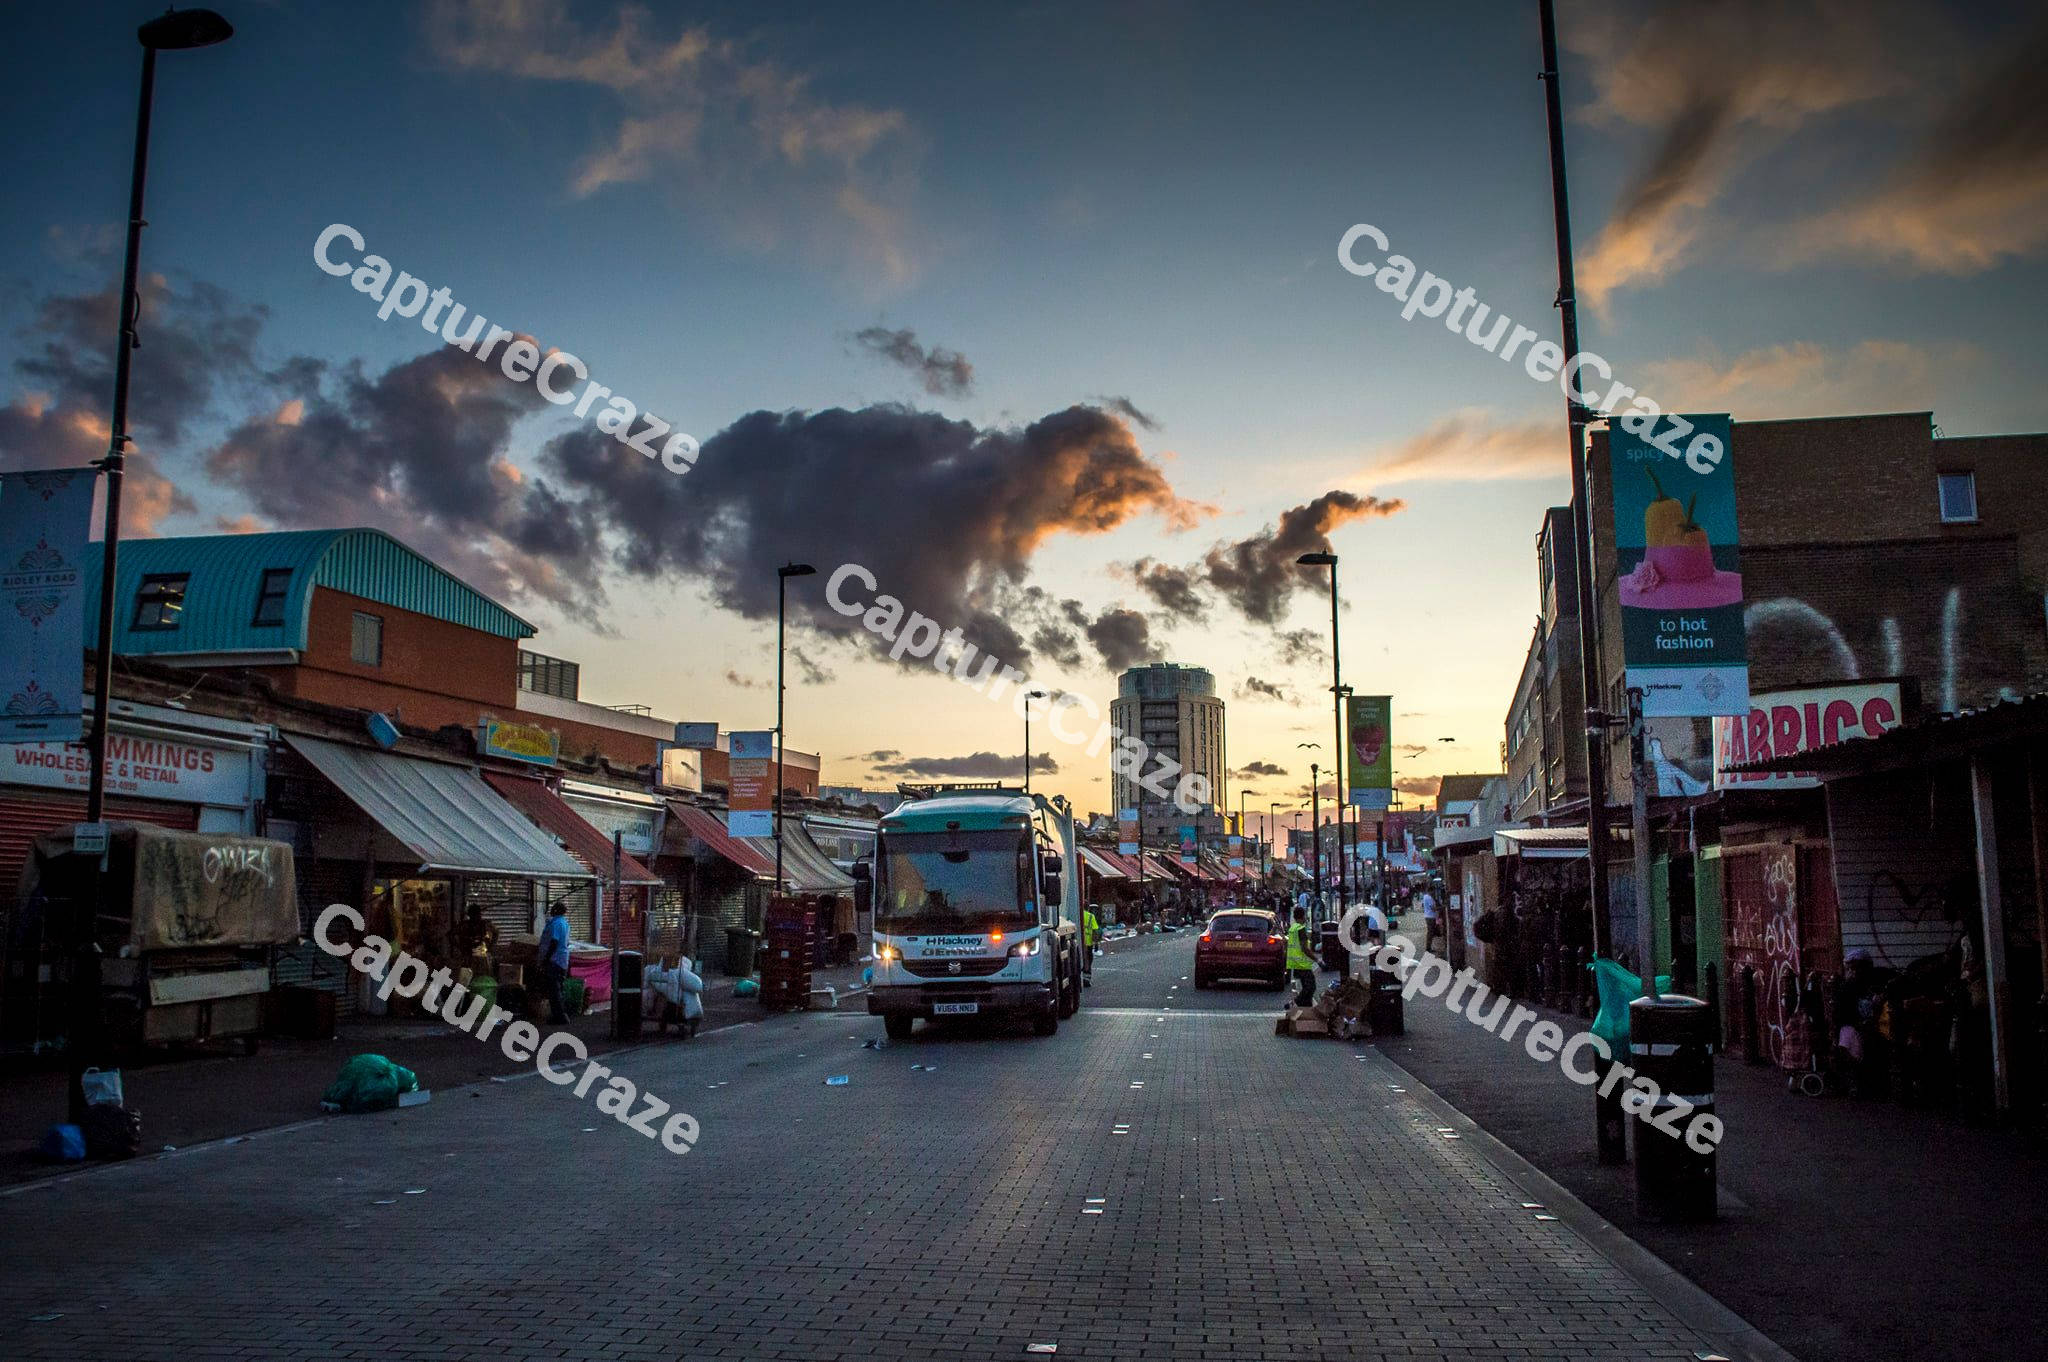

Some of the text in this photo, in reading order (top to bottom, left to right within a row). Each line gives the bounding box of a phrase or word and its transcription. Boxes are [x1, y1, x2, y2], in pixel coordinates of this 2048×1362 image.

[1659, 617, 1708, 631] to hot
[1655, 635, 1714, 649] fashion
[118, 765, 129, 777] &
[134, 765, 179, 785] RETAIL
[937, 936, 983, 946] Hackney
